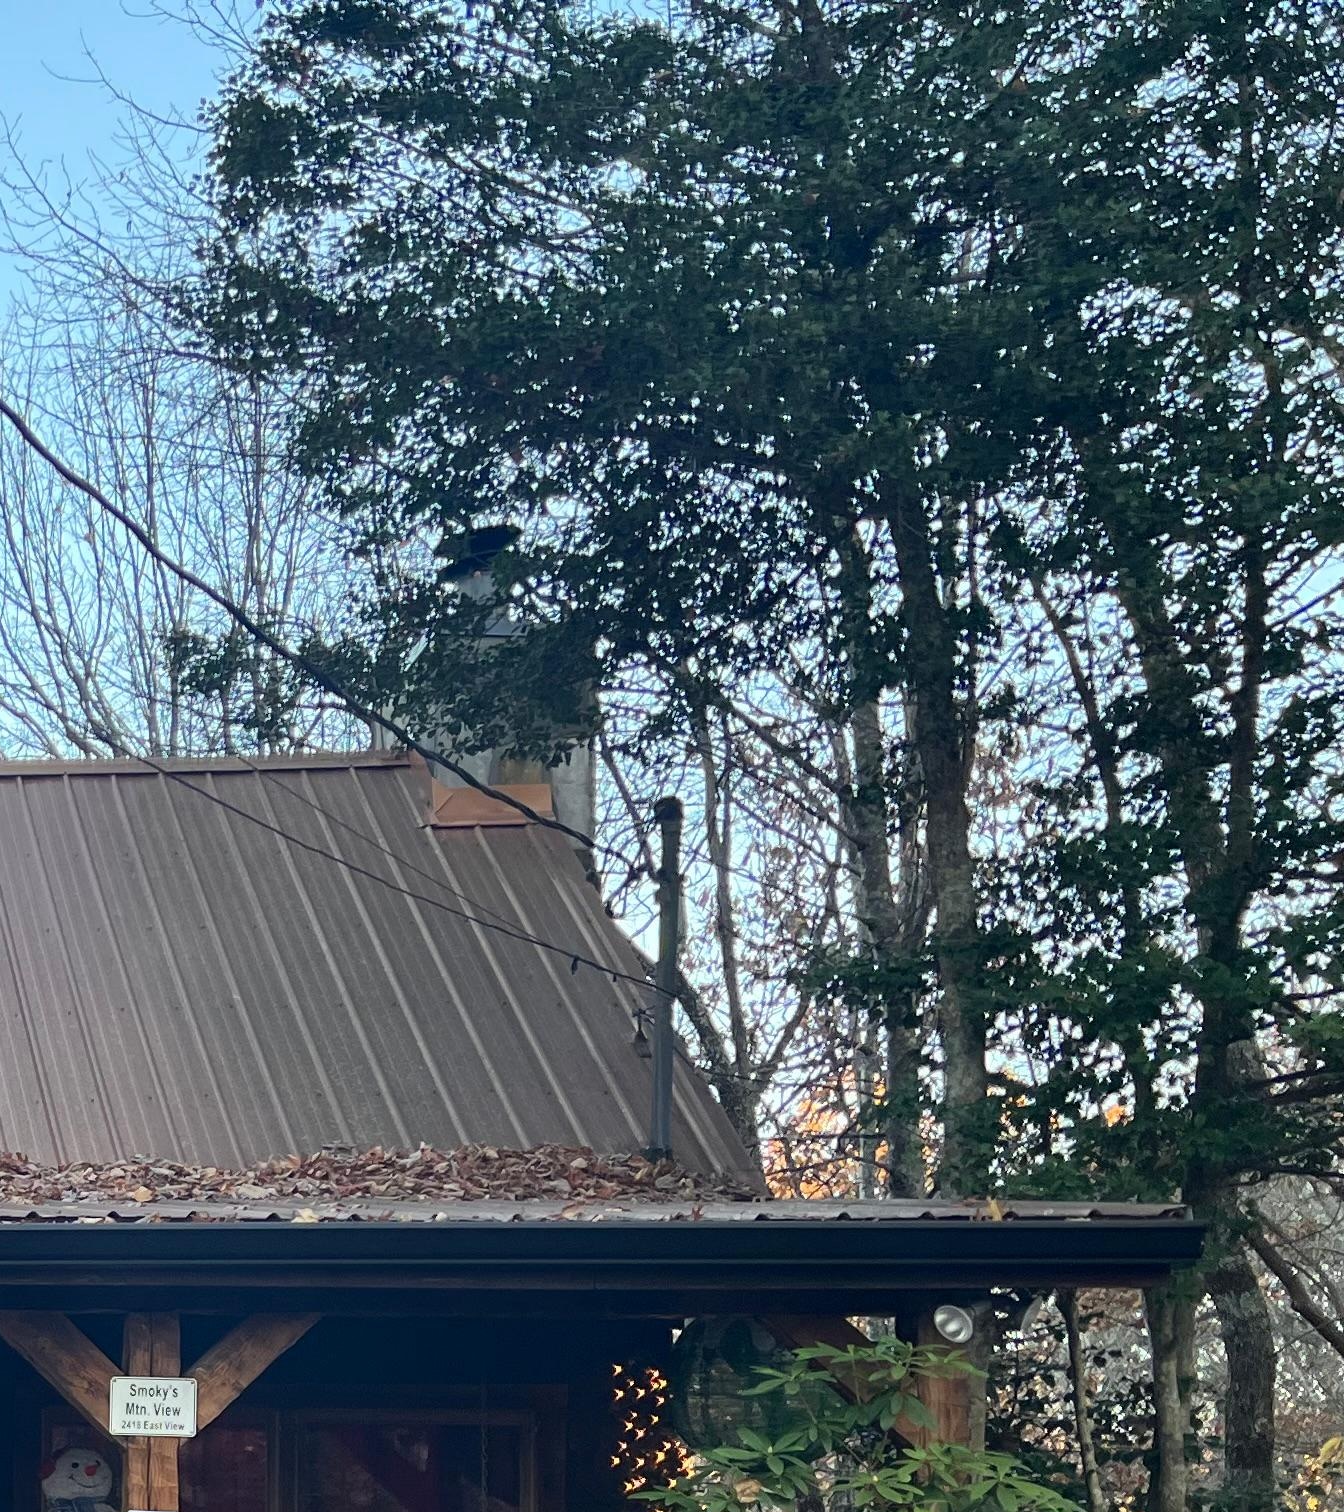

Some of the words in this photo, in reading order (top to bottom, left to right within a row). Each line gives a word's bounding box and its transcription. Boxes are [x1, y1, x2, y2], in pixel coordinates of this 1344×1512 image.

[129, 1384, 179, 1401] Smoky's
[125, 1402, 150, 1416] Mtn.
[153, 1403, 182, 1416] View
[143, 1421, 163, 1431] East
[164, 1421, 185, 1431] View
